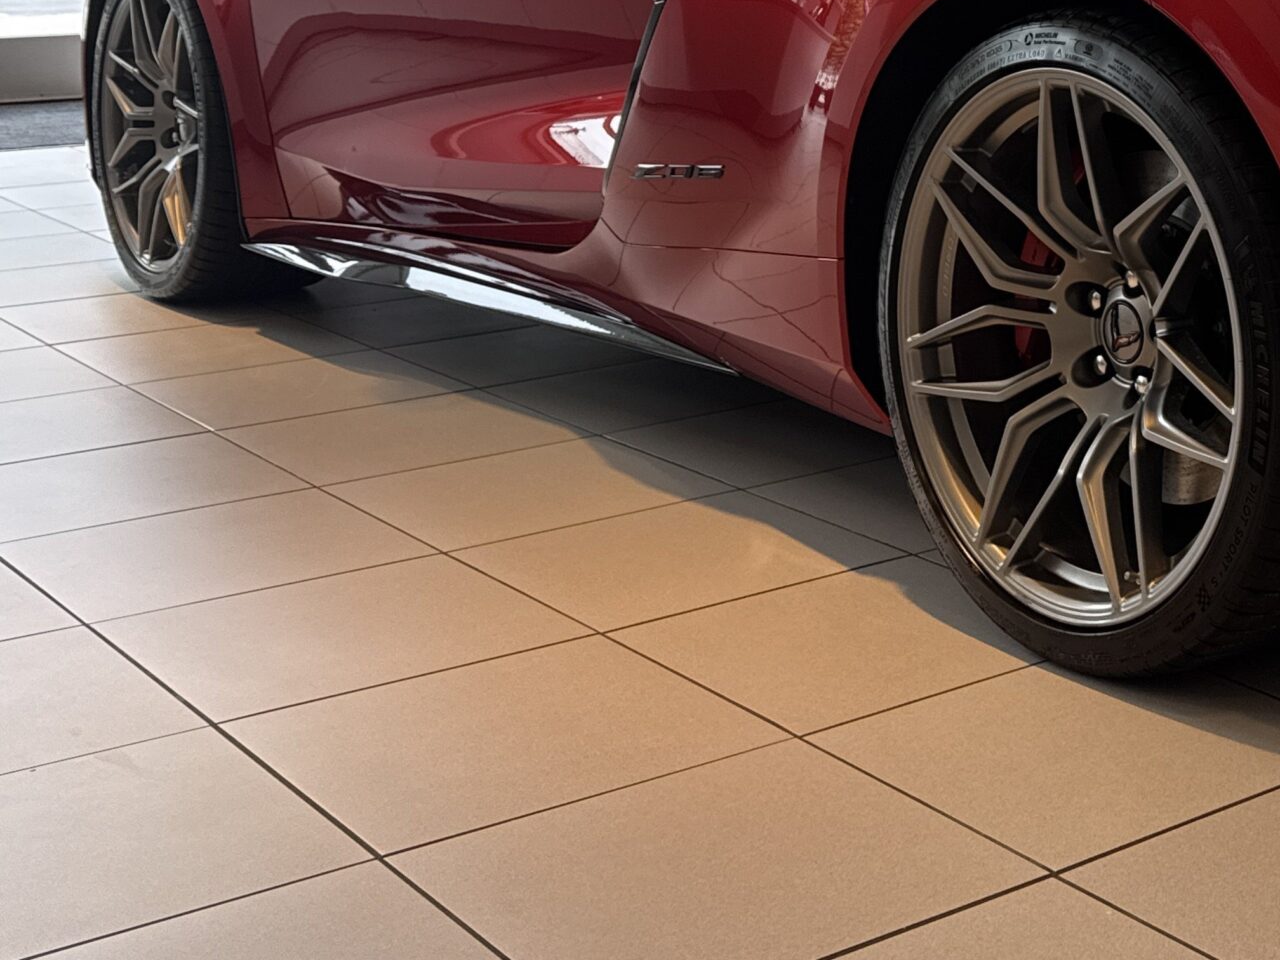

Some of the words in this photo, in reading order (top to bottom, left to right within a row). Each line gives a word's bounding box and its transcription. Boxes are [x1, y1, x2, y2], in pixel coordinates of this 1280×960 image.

[1250, 300, 1272, 468] MICHELIN
[1240, 482, 1259, 527] PILOT
[1221, 527, 1245, 572] SPORT
